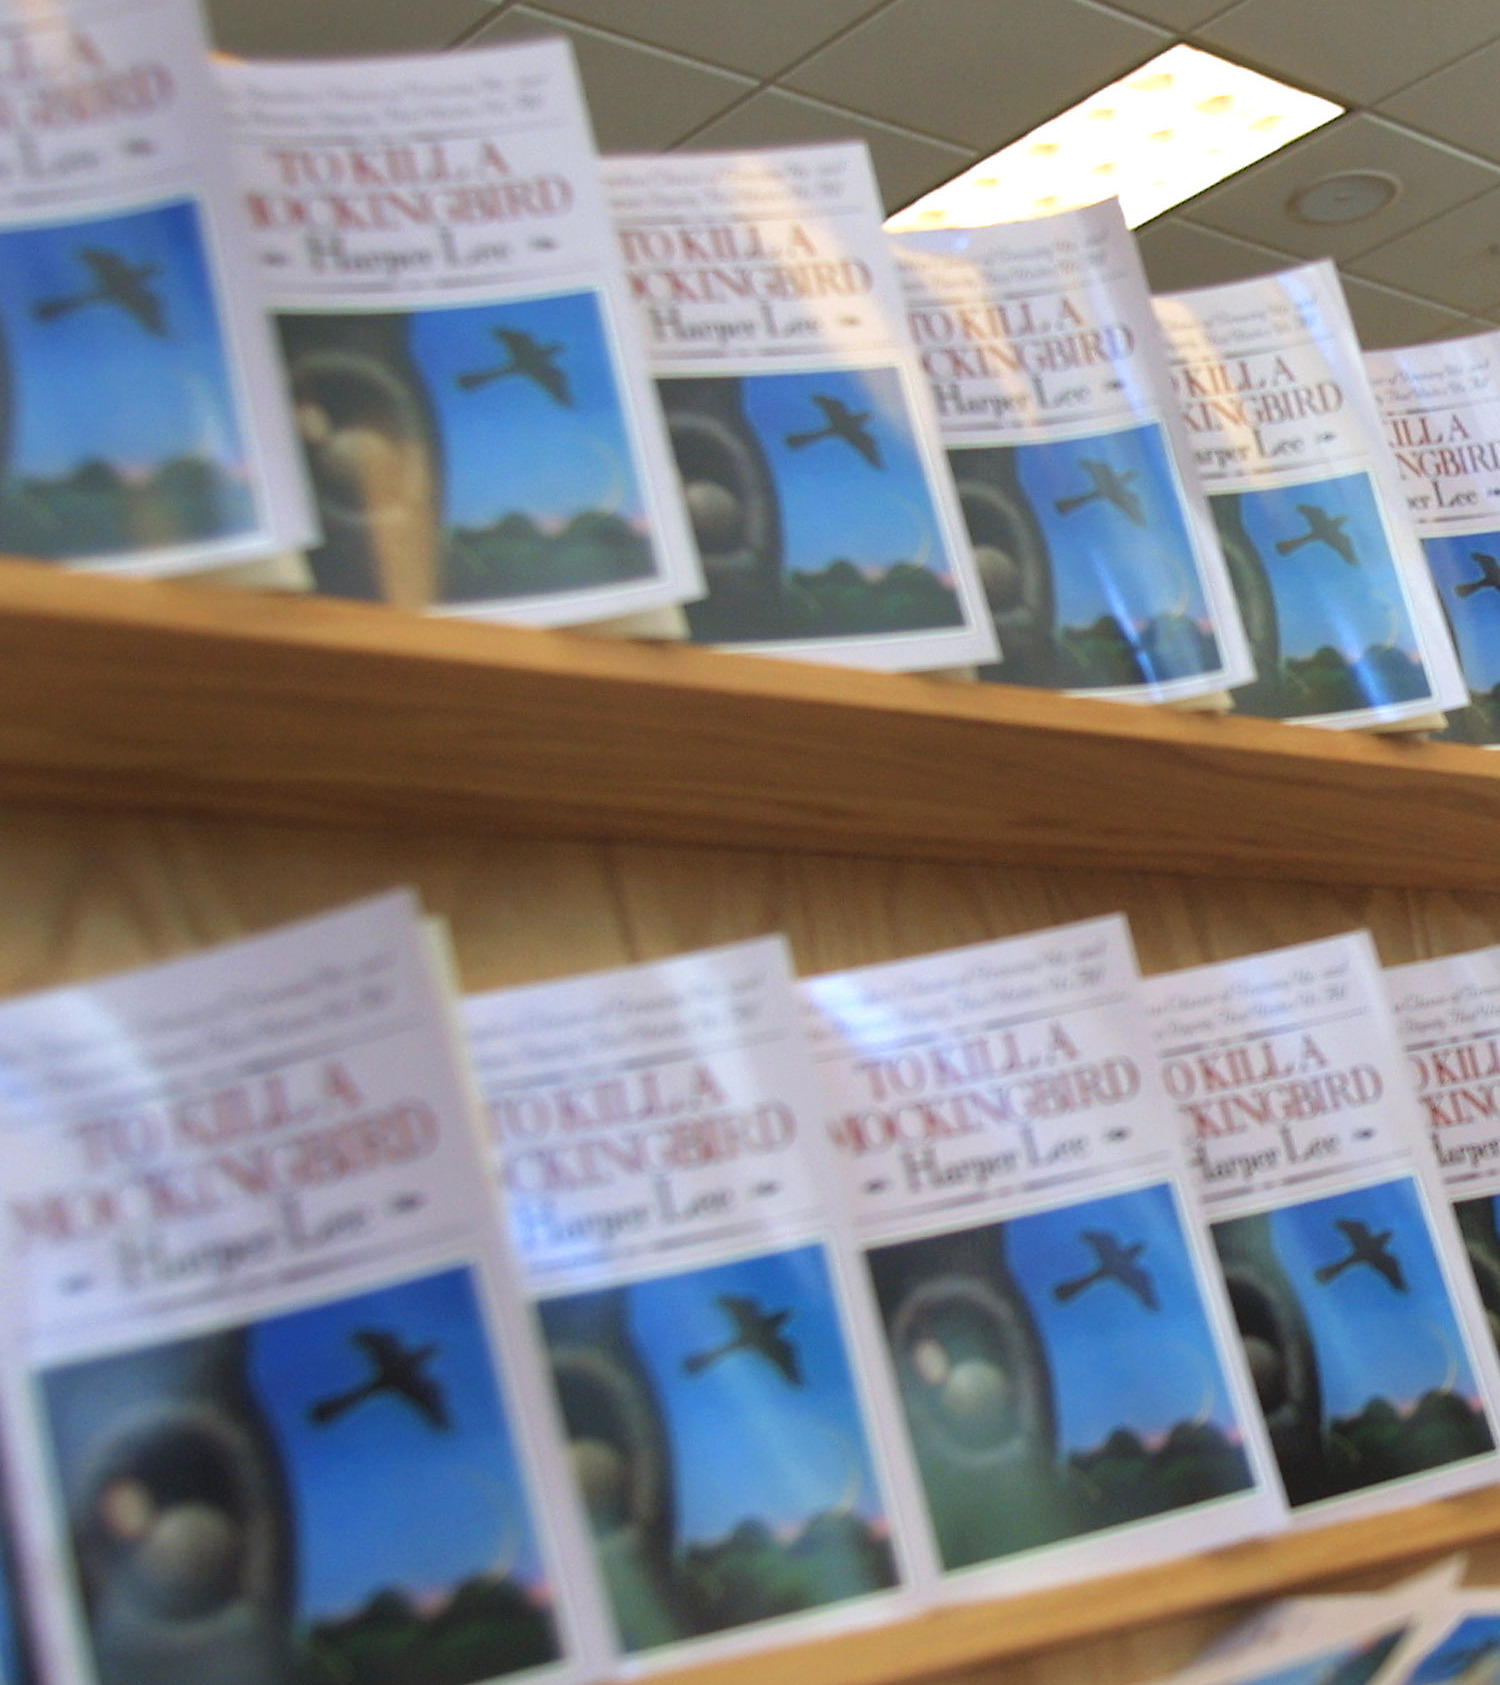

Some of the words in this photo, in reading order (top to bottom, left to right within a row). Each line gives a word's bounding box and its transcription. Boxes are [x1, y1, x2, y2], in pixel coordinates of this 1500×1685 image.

[757, 300, 819, 337] Lee
[1055, 298, 1084, 327] A
[1030, 372, 1092, 409] Lee
[1183, 360, 1267, 398] KILL
[1271, 356, 1297, 387] A
[1252, 427, 1304, 458] Lee
[1388, 416, 1443, 449] ILL
[1448, 413, 1470, 441] A
[1431, 479, 1478, 508] Lee
[1198, 1041, 1295, 1092] KILL
[1301, 1033, 1329, 1074] A
[1178, 1062, 1384, 1140] KINGBIRD
[1018, 1121, 1089, 1168] Lee
[1279, 1122, 1342, 1165] Lee
